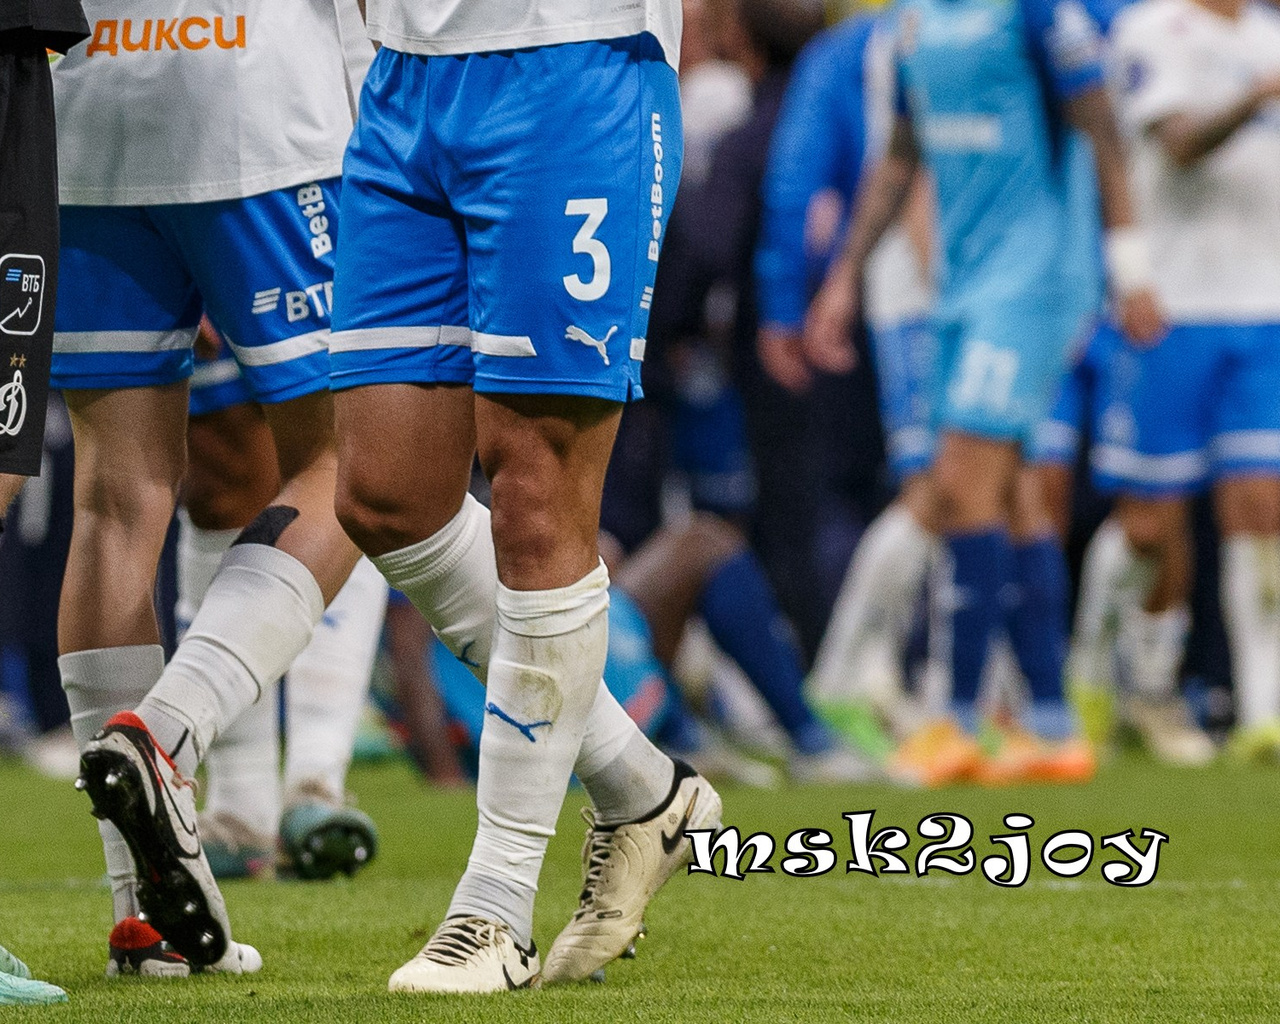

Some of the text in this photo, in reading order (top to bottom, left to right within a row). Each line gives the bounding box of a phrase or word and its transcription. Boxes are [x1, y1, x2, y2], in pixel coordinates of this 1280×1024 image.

[648, 112, 664, 262] BetBoom
[22, 274, 40, 293] ВТБ
[563, 198, 612, 302] 3
